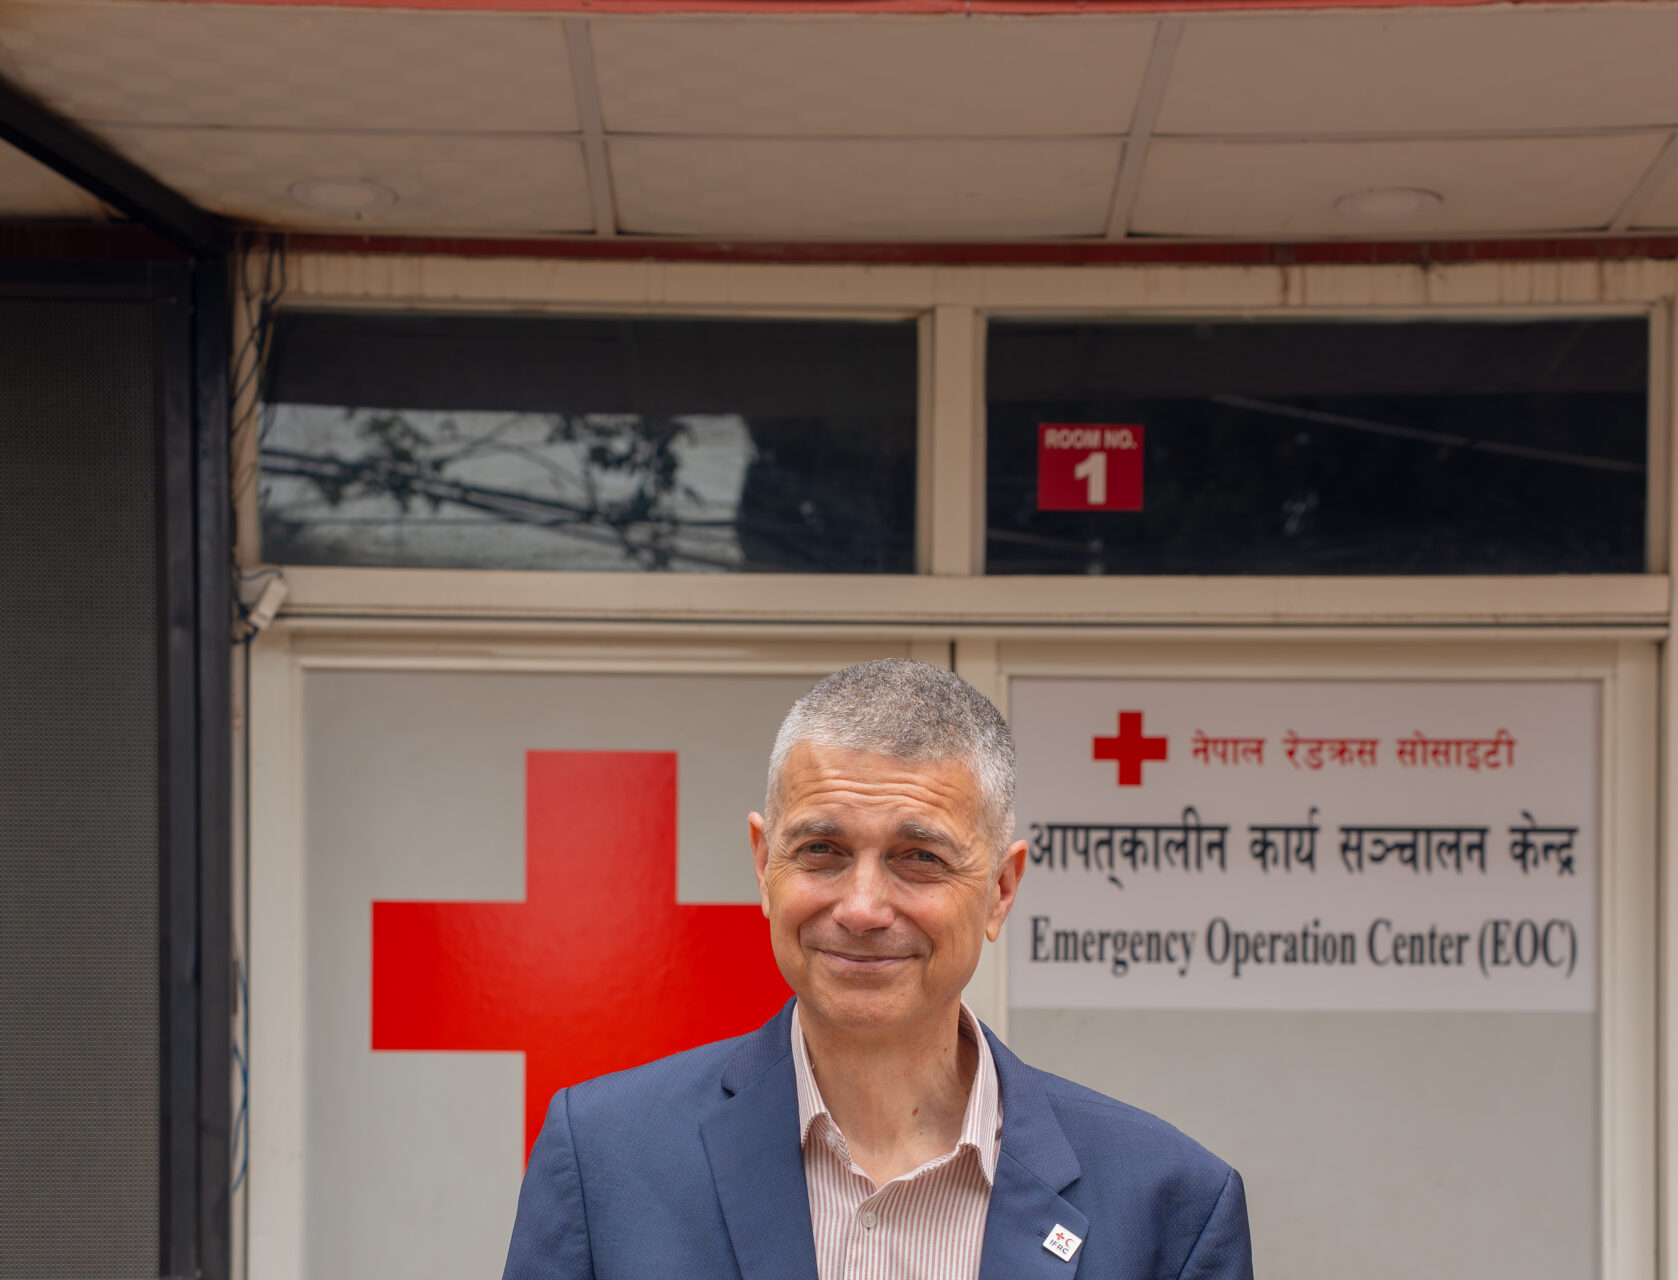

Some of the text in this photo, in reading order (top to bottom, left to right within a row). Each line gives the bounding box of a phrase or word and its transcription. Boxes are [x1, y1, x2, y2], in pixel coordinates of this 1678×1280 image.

[1044, 428, 1138, 450] ROOM NO.
[1074, 451, 1108, 506] 1
[1191, 727, 1517, 772] नेपाल रेडक्रस सोसाइटी
[1028, 804, 1579, 890] आपत्कालीन कार्य सञ्चालन केन्द्र
[1029, 915, 1578, 979] Emergency Operation Center (EOC)
[1049, 1239, 1069, 1255] IFRC
